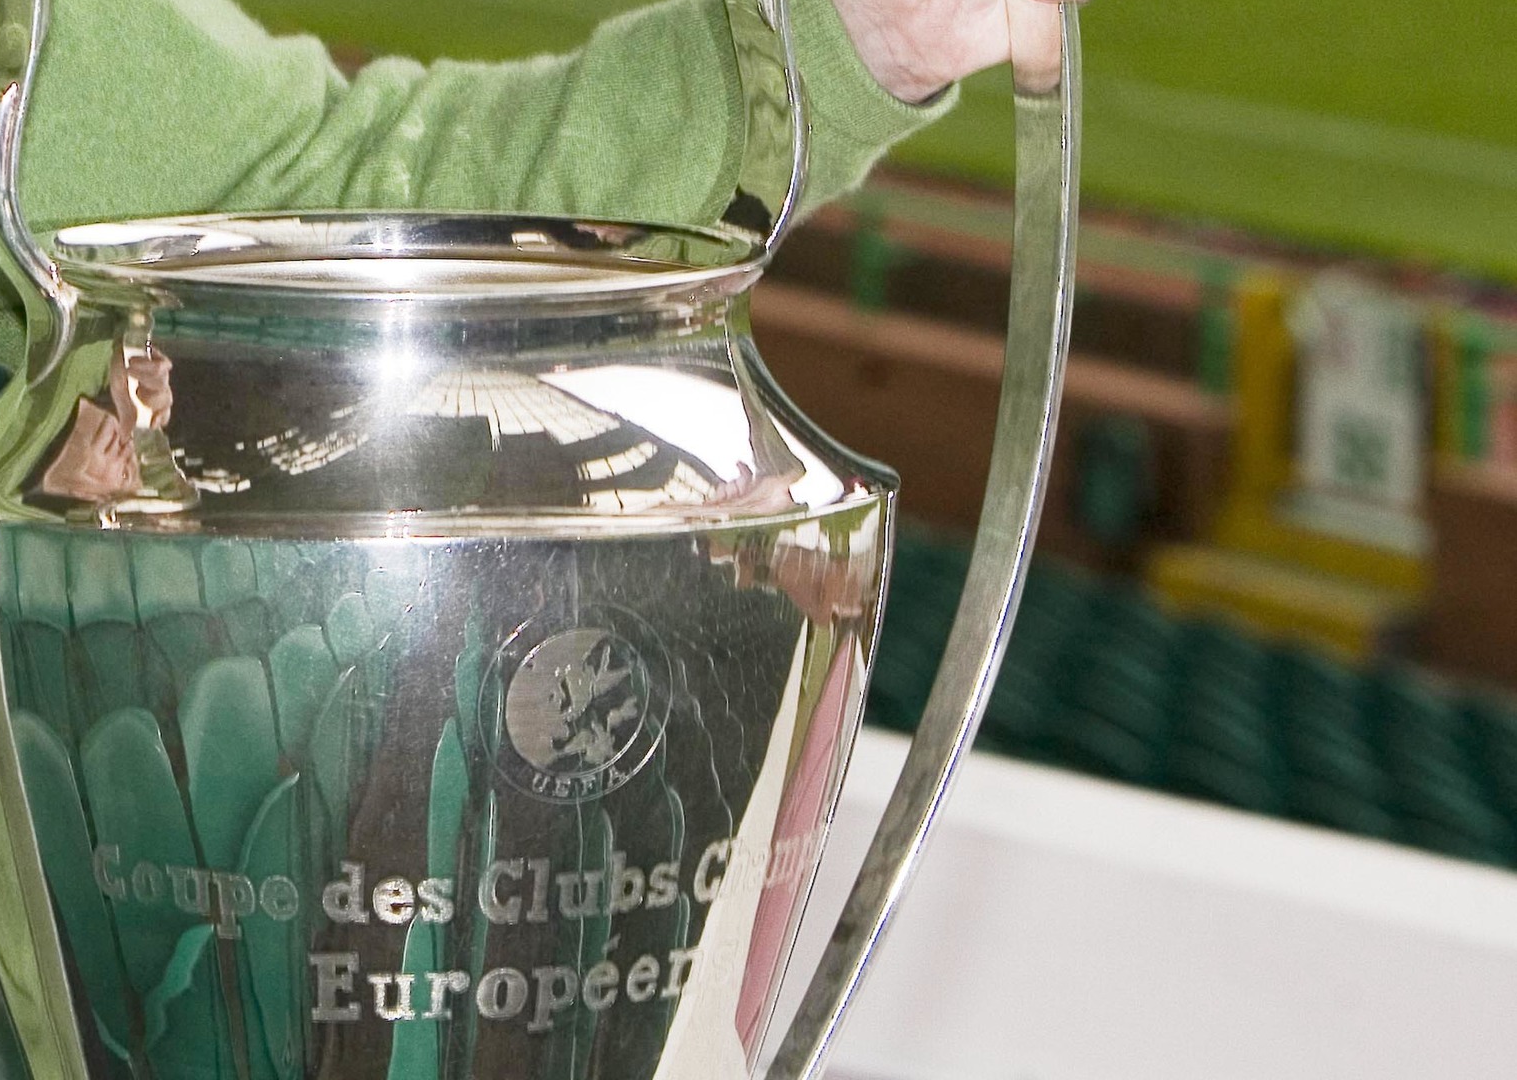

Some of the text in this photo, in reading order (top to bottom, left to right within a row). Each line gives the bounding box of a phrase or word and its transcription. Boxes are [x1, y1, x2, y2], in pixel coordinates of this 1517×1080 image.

[532, 765, 630, 798] UEFA
[93, 844, 299, 940] Coupe
[322, 860, 455, 925] des
[477, 850, 679, 924] Clubs
